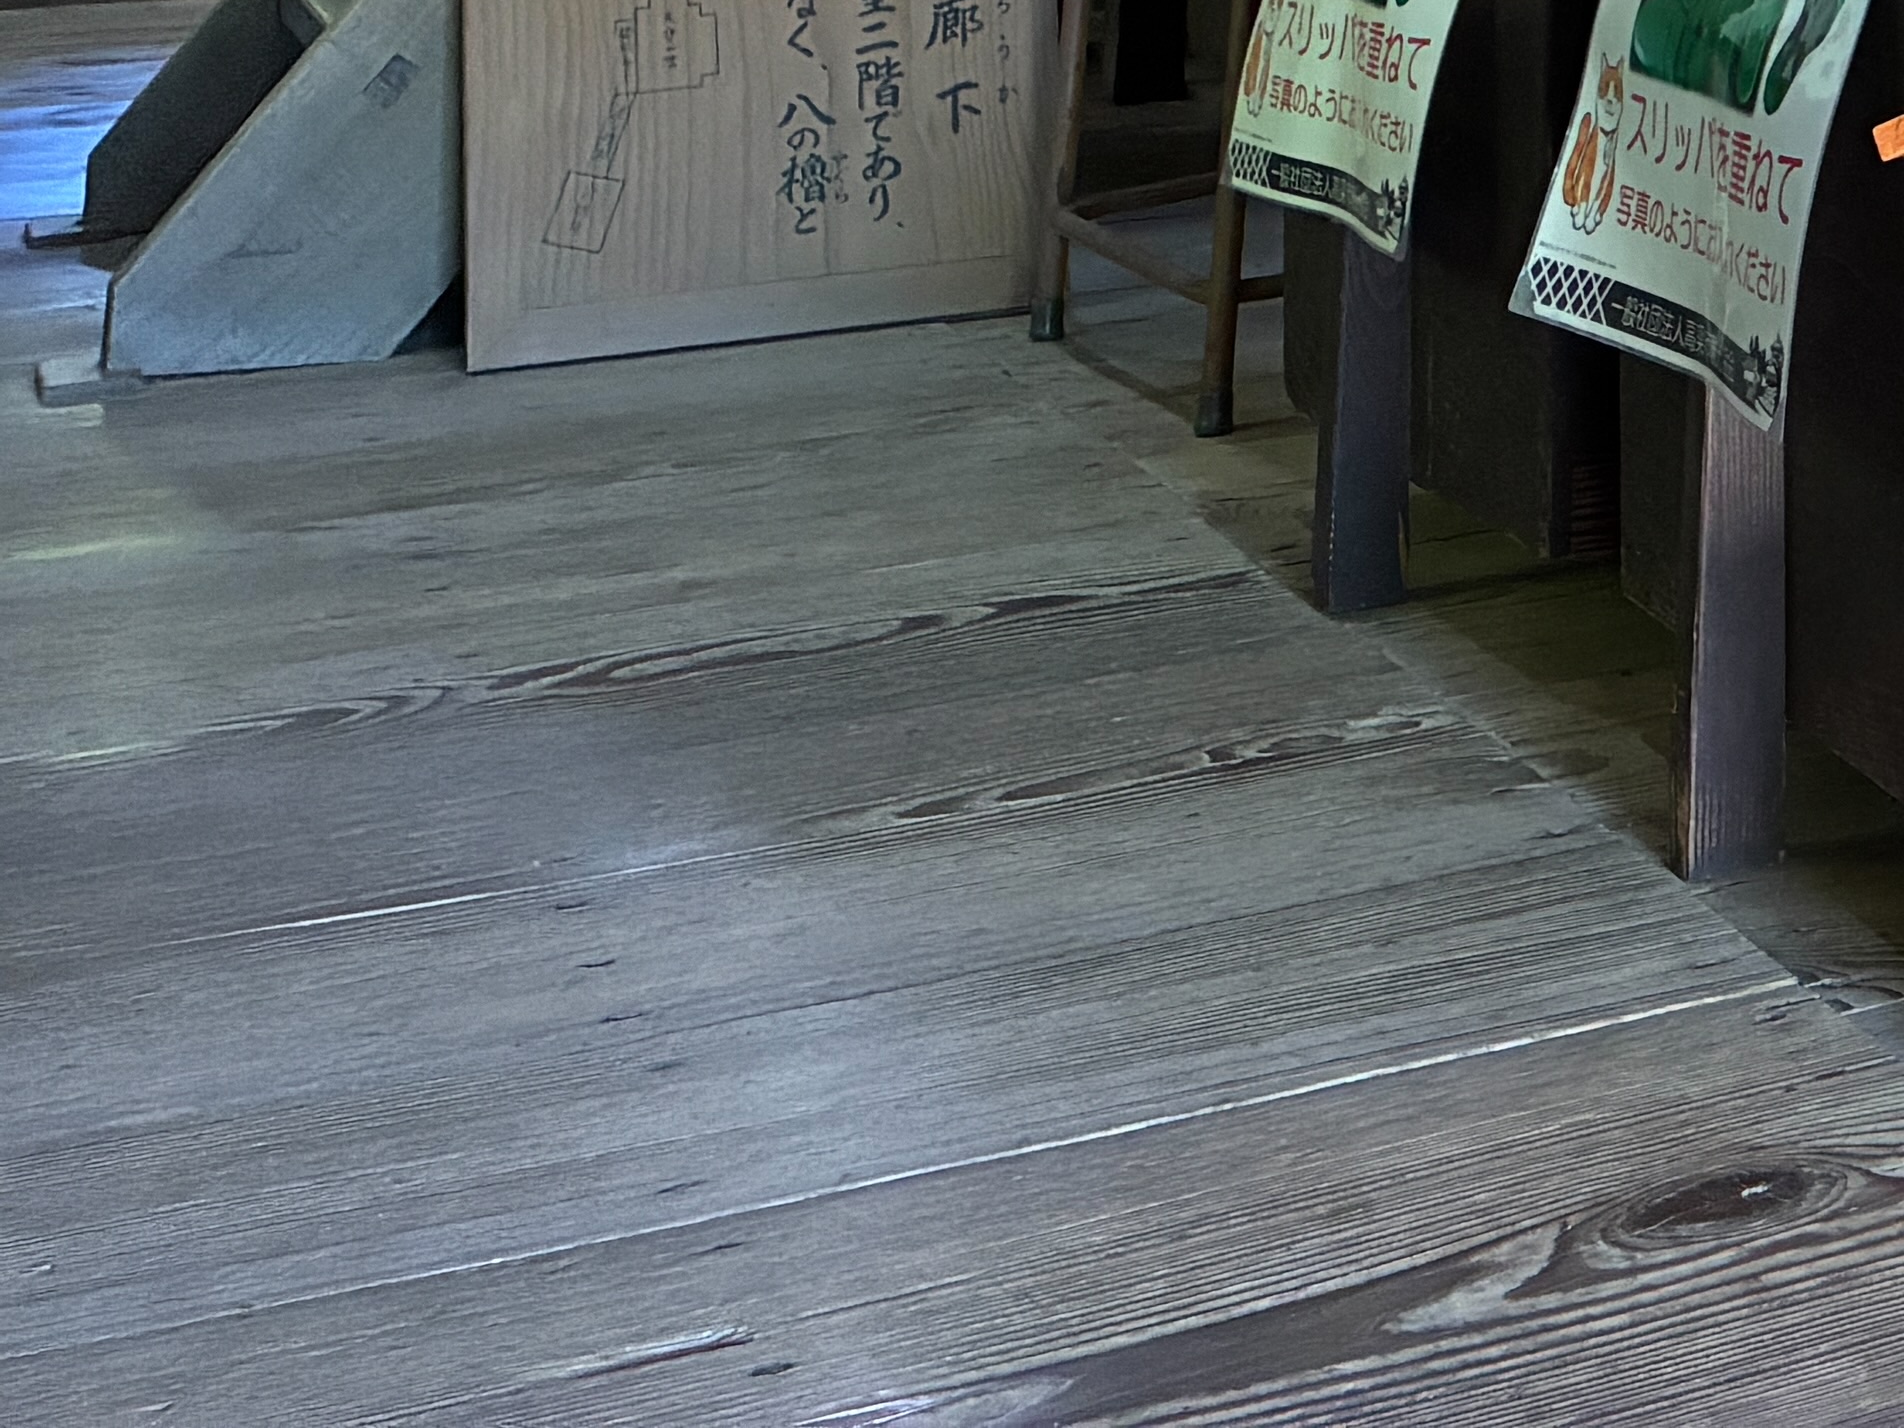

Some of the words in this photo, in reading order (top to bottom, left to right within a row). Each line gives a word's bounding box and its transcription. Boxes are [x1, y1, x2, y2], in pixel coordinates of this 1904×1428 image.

[1627, 93, 1803, 225] スリッパを重ねて
